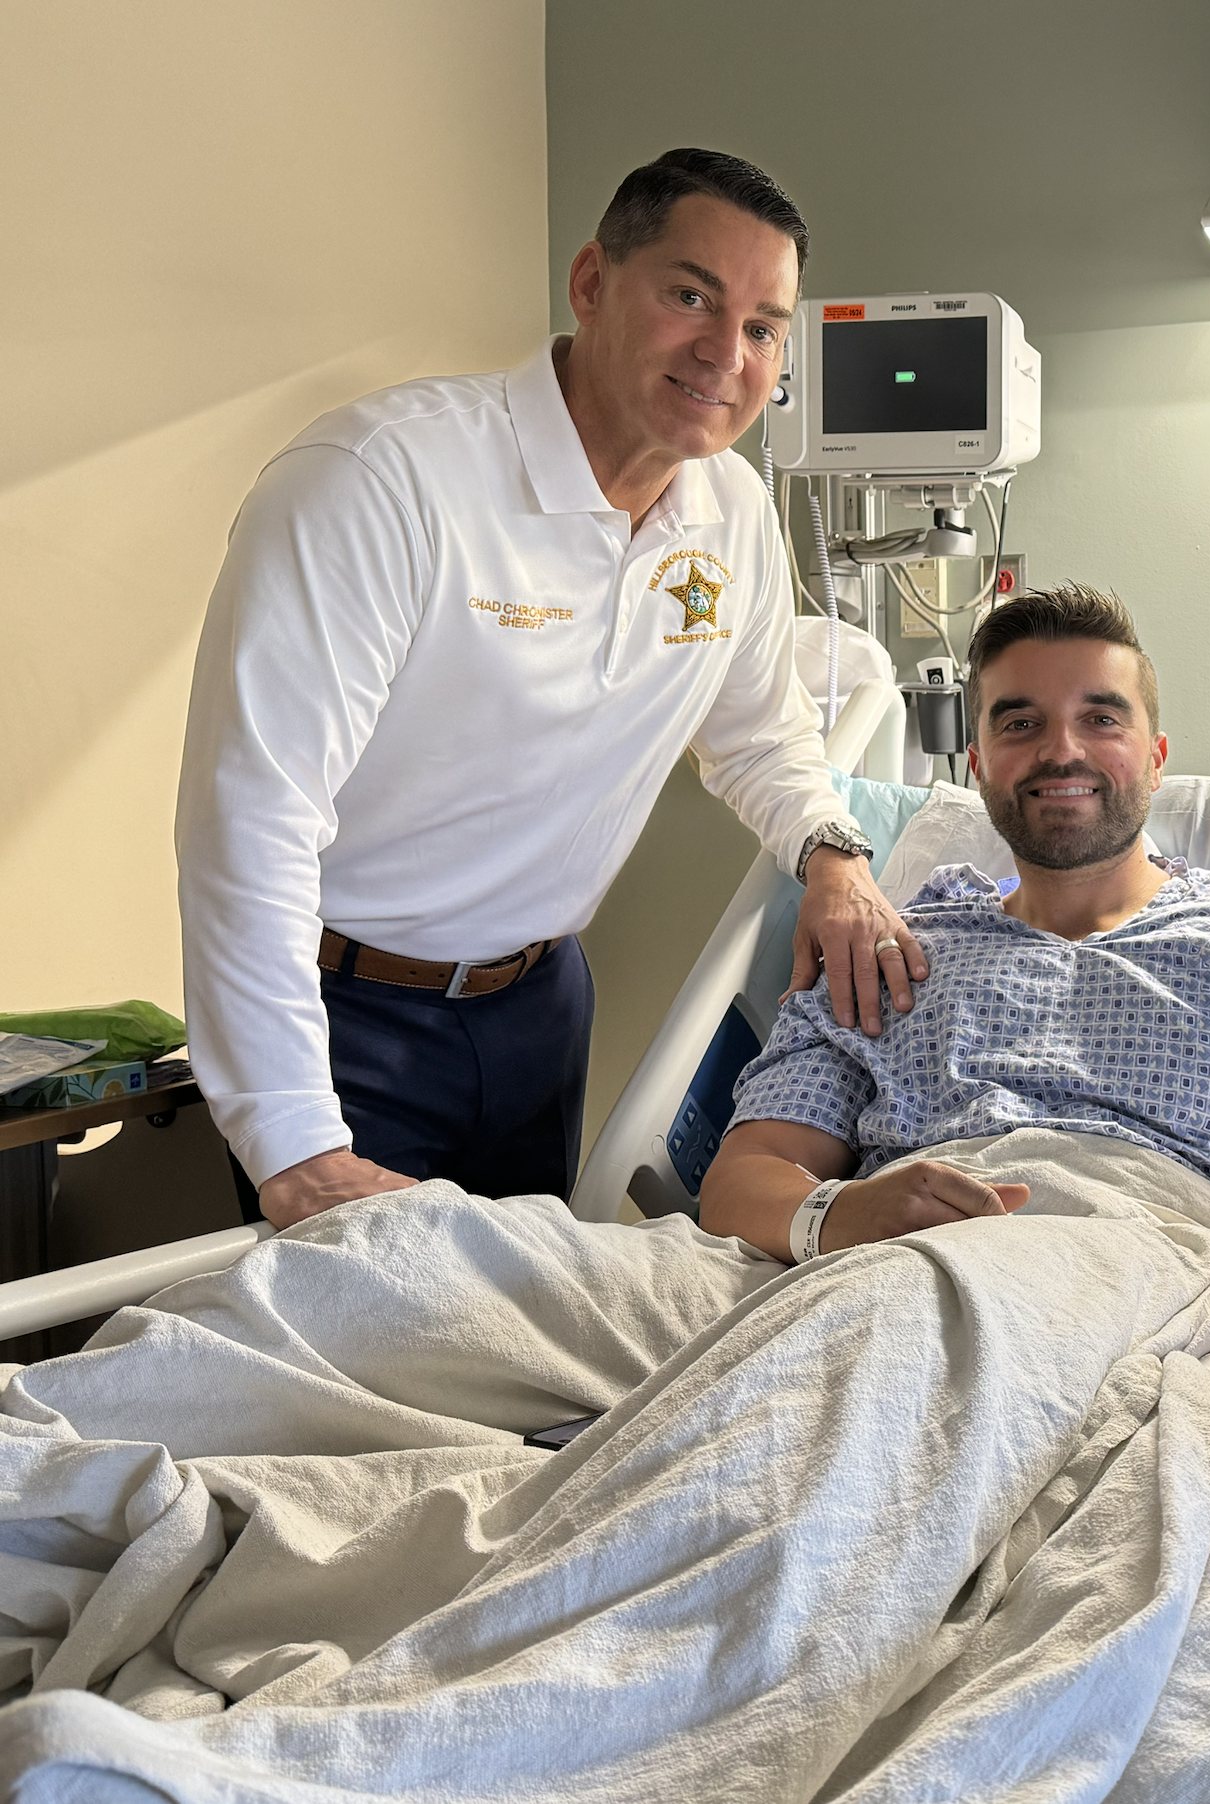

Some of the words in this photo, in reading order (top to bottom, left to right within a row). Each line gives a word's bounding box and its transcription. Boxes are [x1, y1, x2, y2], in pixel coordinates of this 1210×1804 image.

[958, 440, 980, 448] C826-1
[647, 549, 705, 592] HILLSBOROUGH
[706, 553, 735, 585] COUNTY
[468, 597, 501, 613] CHAD
[503, 602, 574, 621] CHRONISTER
[498, 614, 545, 631] SHERIFF
[663, 632, 708, 645] SHERIFF'S
